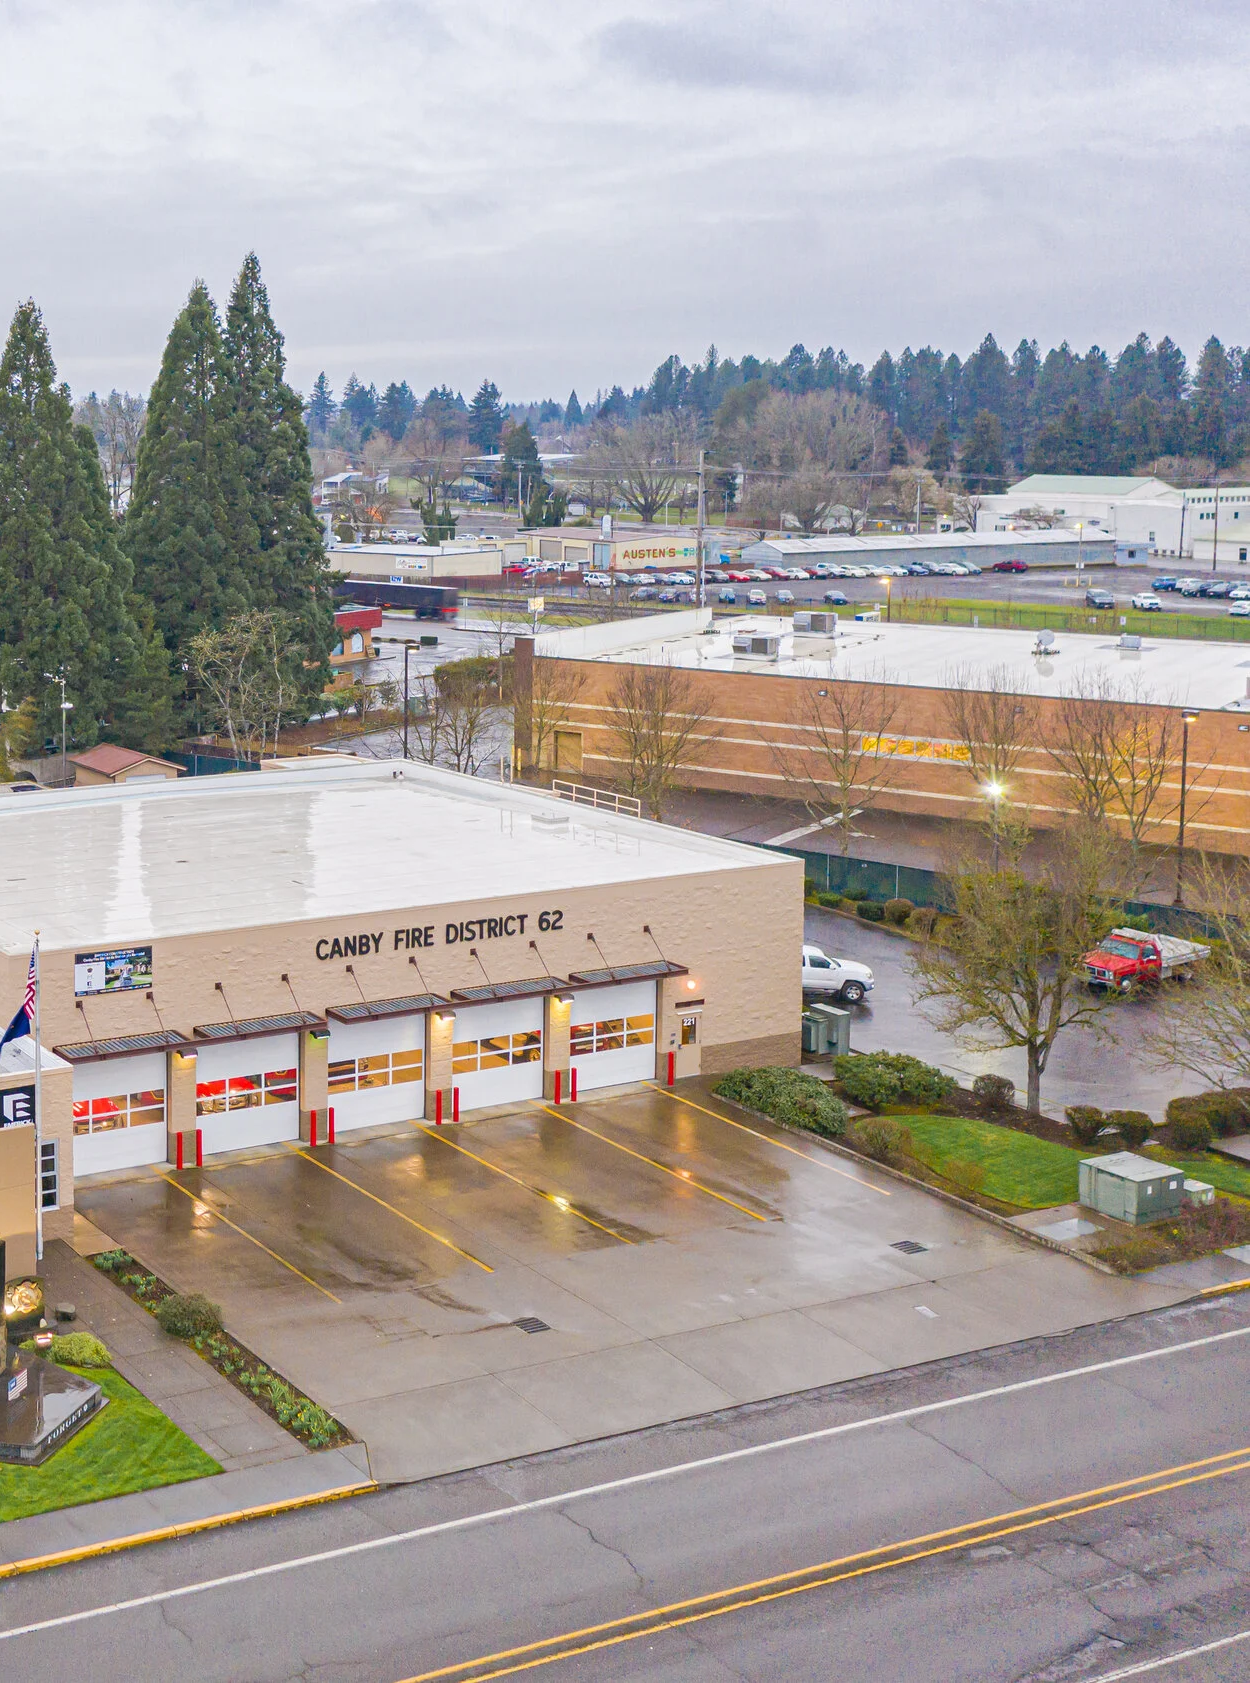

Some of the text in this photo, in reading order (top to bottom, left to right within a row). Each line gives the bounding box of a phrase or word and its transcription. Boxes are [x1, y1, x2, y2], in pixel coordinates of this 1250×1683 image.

[623, 547, 677, 560] AUSTEN'S
[315, 909, 564, 961] CANBY FIRE DISTRICT 62
[683, 1017, 695, 1026] 221
[47, 1407, 83, 1444] FORGET
